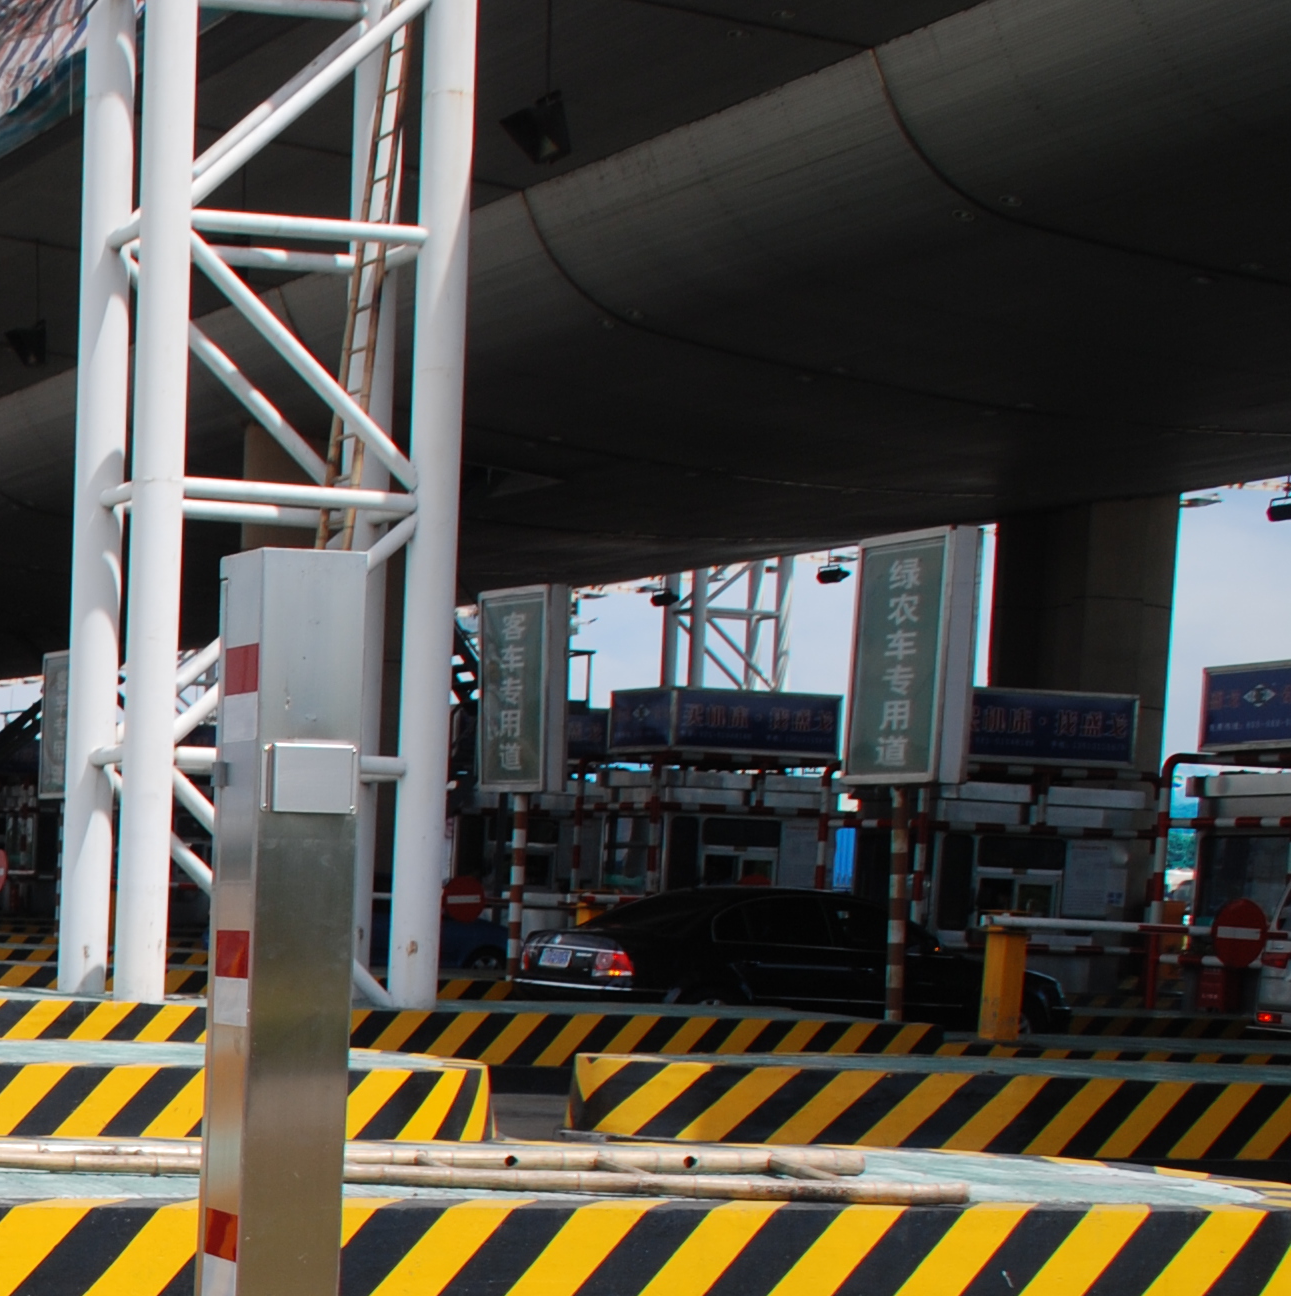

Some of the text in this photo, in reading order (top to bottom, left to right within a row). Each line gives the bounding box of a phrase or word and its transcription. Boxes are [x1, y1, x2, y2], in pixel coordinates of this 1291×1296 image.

[498, 611, 526, 771] 客车专用道
[874, 557, 921, 766] 绿农车专用道
